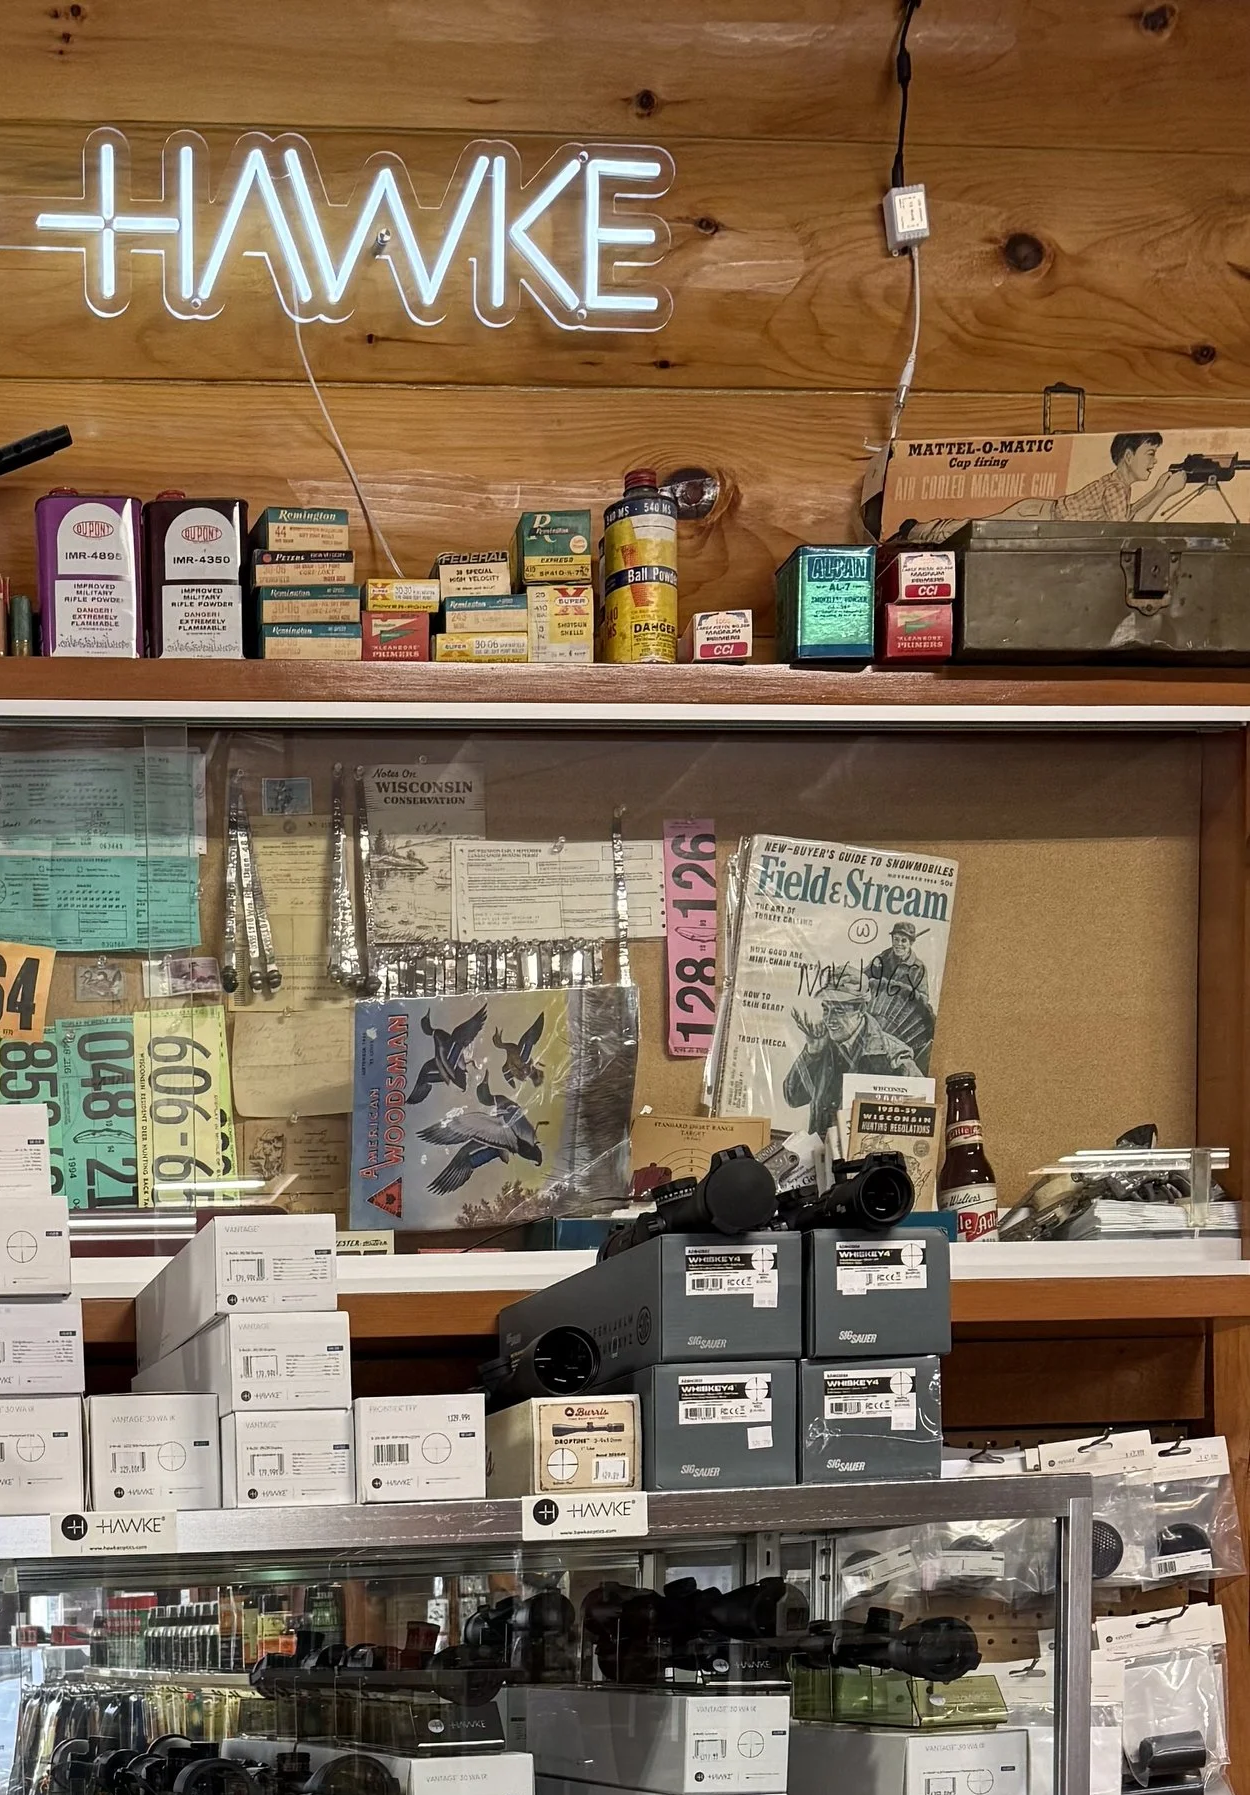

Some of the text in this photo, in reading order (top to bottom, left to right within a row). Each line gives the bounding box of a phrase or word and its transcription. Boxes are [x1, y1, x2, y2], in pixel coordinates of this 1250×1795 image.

[33, 142, 663, 310] HAWKE
[908, 440, 1053, 456] MATTEL-O-MATIC
[949, 457, 1009, 470] Cap firing
[895, 472, 1057, 500] AIR COOLED MACHINE GUN
[278, 509, 336, 522] Remington
[173, 556, 231, 564] IMR-4350
[440, 552, 507, 564] FEDERAL
[628, 567, 677, 584] Ball Powde
[918, 586, 938, 596] CCI
[714, 645, 734, 655] CCI
[372, 768, 417, 778] Notes On
[375, 781, 473, 793] WISCONSIN
[765, 842, 955, 877] NEW-BUYER'S GUIDE TO SNOWMOBILES
[754, 855, 831, 905] Field
[843, 868, 949, 921] Stream
[386, 1013, 408, 1168] WOODSMAN
[863, 1114, 932, 1123] WISCONSIN
[359, 1087, 380, 1179] AMERICAN
[688, 1255, 741, 1264] WHISKEY4
[839, 1250, 891, 1258] WHISKEY4
[687, 1335, 727, 1349] SIG SAUER
[839, 1330, 877, 1344] SIG SAUER
[681, 1384, 735, 1394] WHISKEY4
[827, 1379, 879, 1388] WHISKEY4
[575, 1407, 609, 1416] Burris
[681, 1464, 720, 1477] SIG SAUER
[827, 1459, 865, 1472] SIG SAUER
